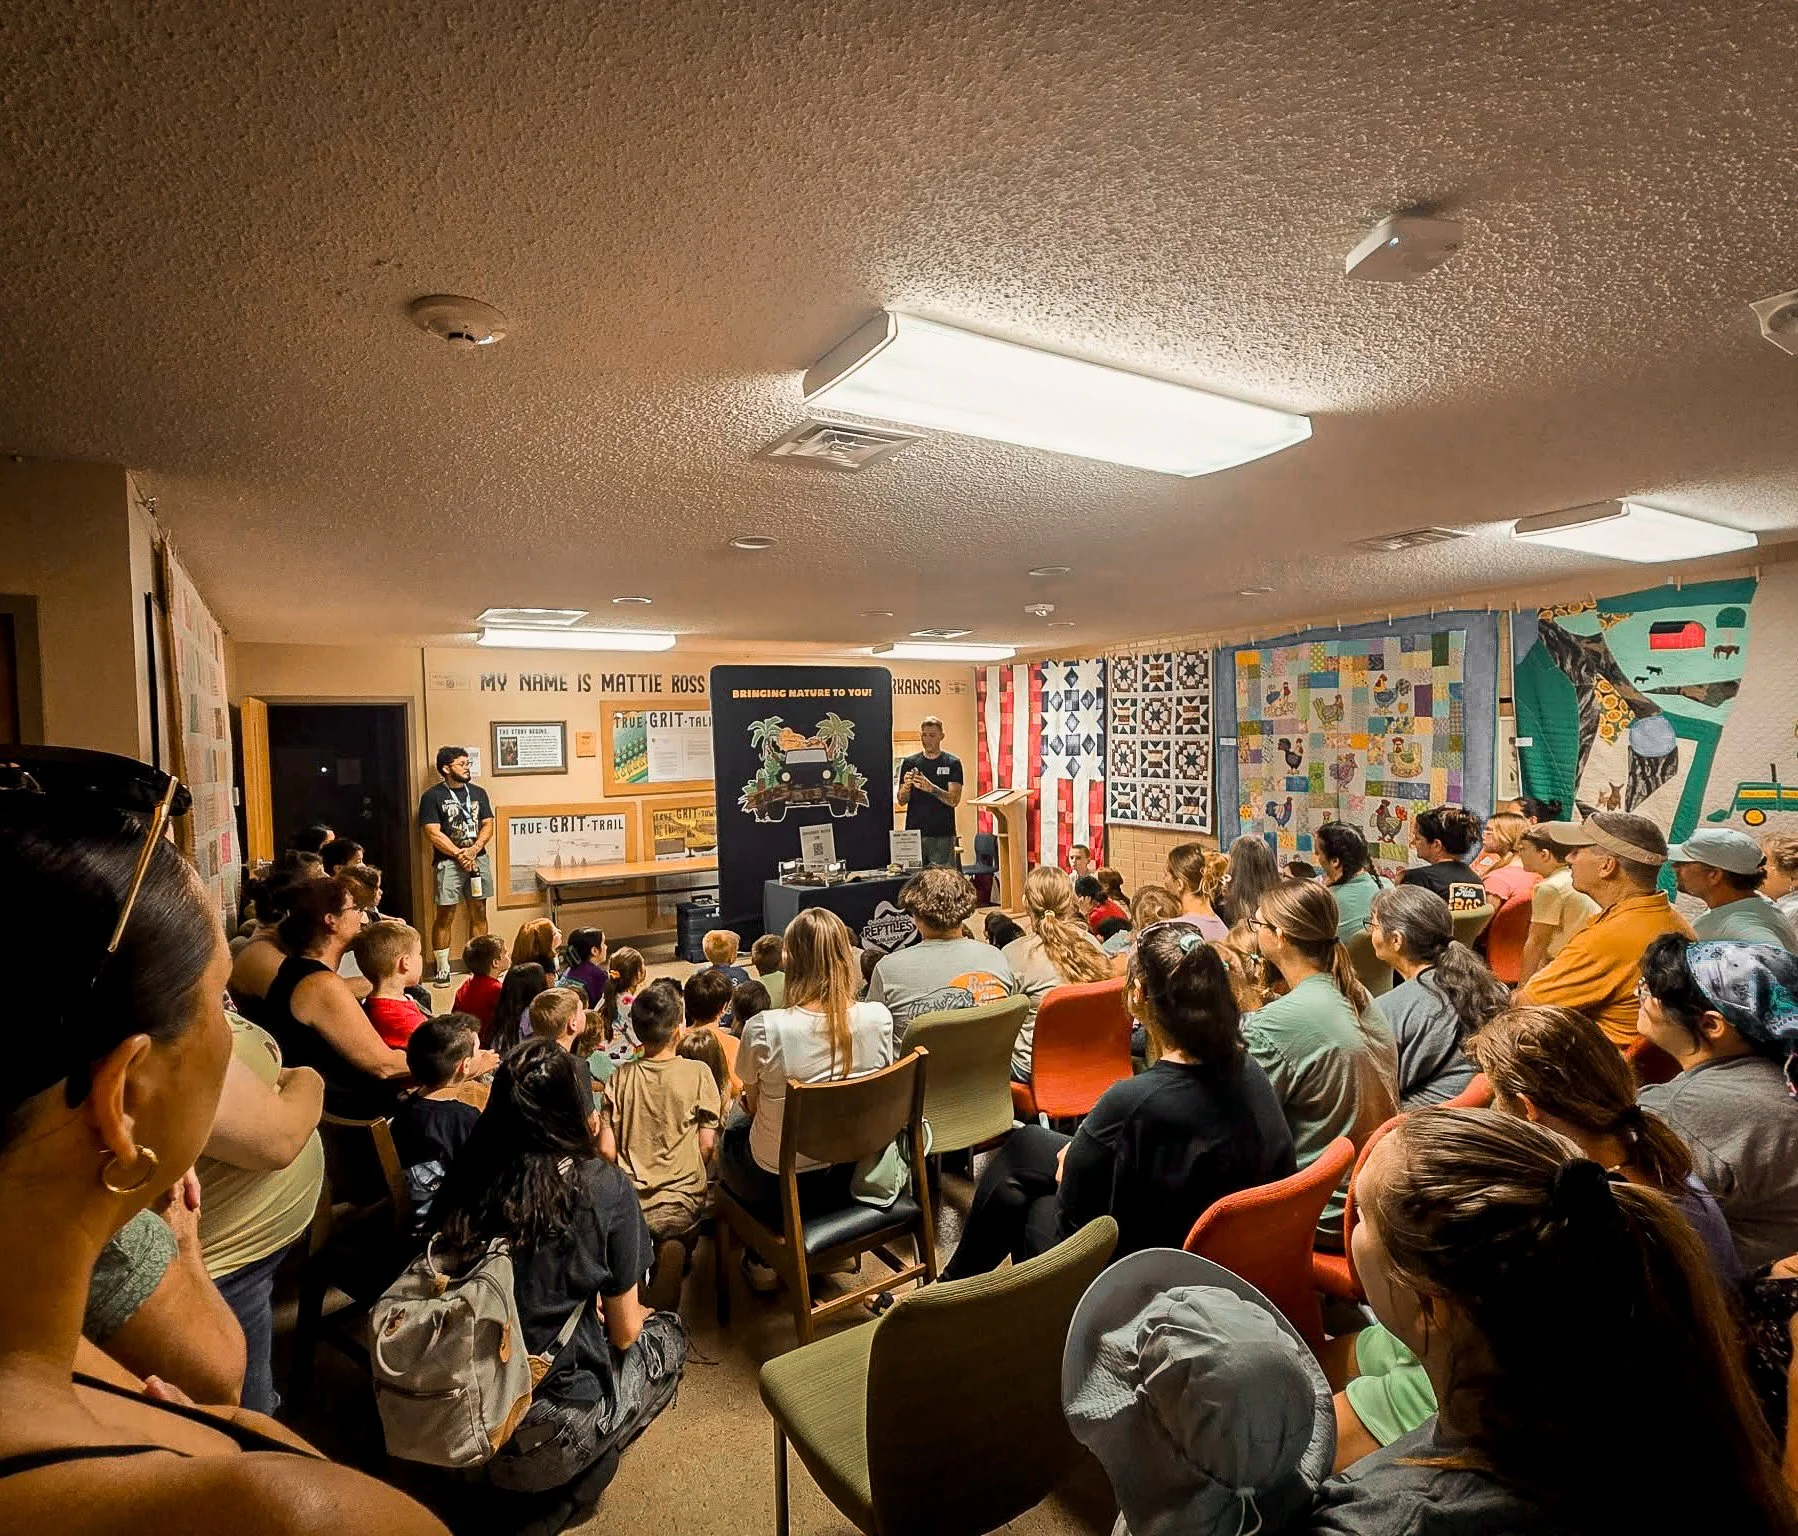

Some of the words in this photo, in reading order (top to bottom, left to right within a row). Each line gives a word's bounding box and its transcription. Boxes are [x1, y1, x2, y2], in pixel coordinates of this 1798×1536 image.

[480, 672, 507, 692] MY
[519, 672, 569, 692] NAME
[577, 673, 591, 692] IS
[601, 673, 662, 693] MATTIE
[671, 674, 706, 693] ROSS
[893, 679, 941, 695] RKANSAS
[732, 689, 787, 699] BRINGING
[788, 688, 831, 698] NATURE
[832, 688, 846, 697] TO
[847, 688, 873, 697] YOU!
[613, 716, 643, 729] TRUE
[649, 712, 684, 728] GRIT
[511, 822, 542, 835] TRUE
[549, 815, 587, 833] GRIT
[591, 818, 624, 831] TRAIL
[863, 920, 914, 938] REPTILES
